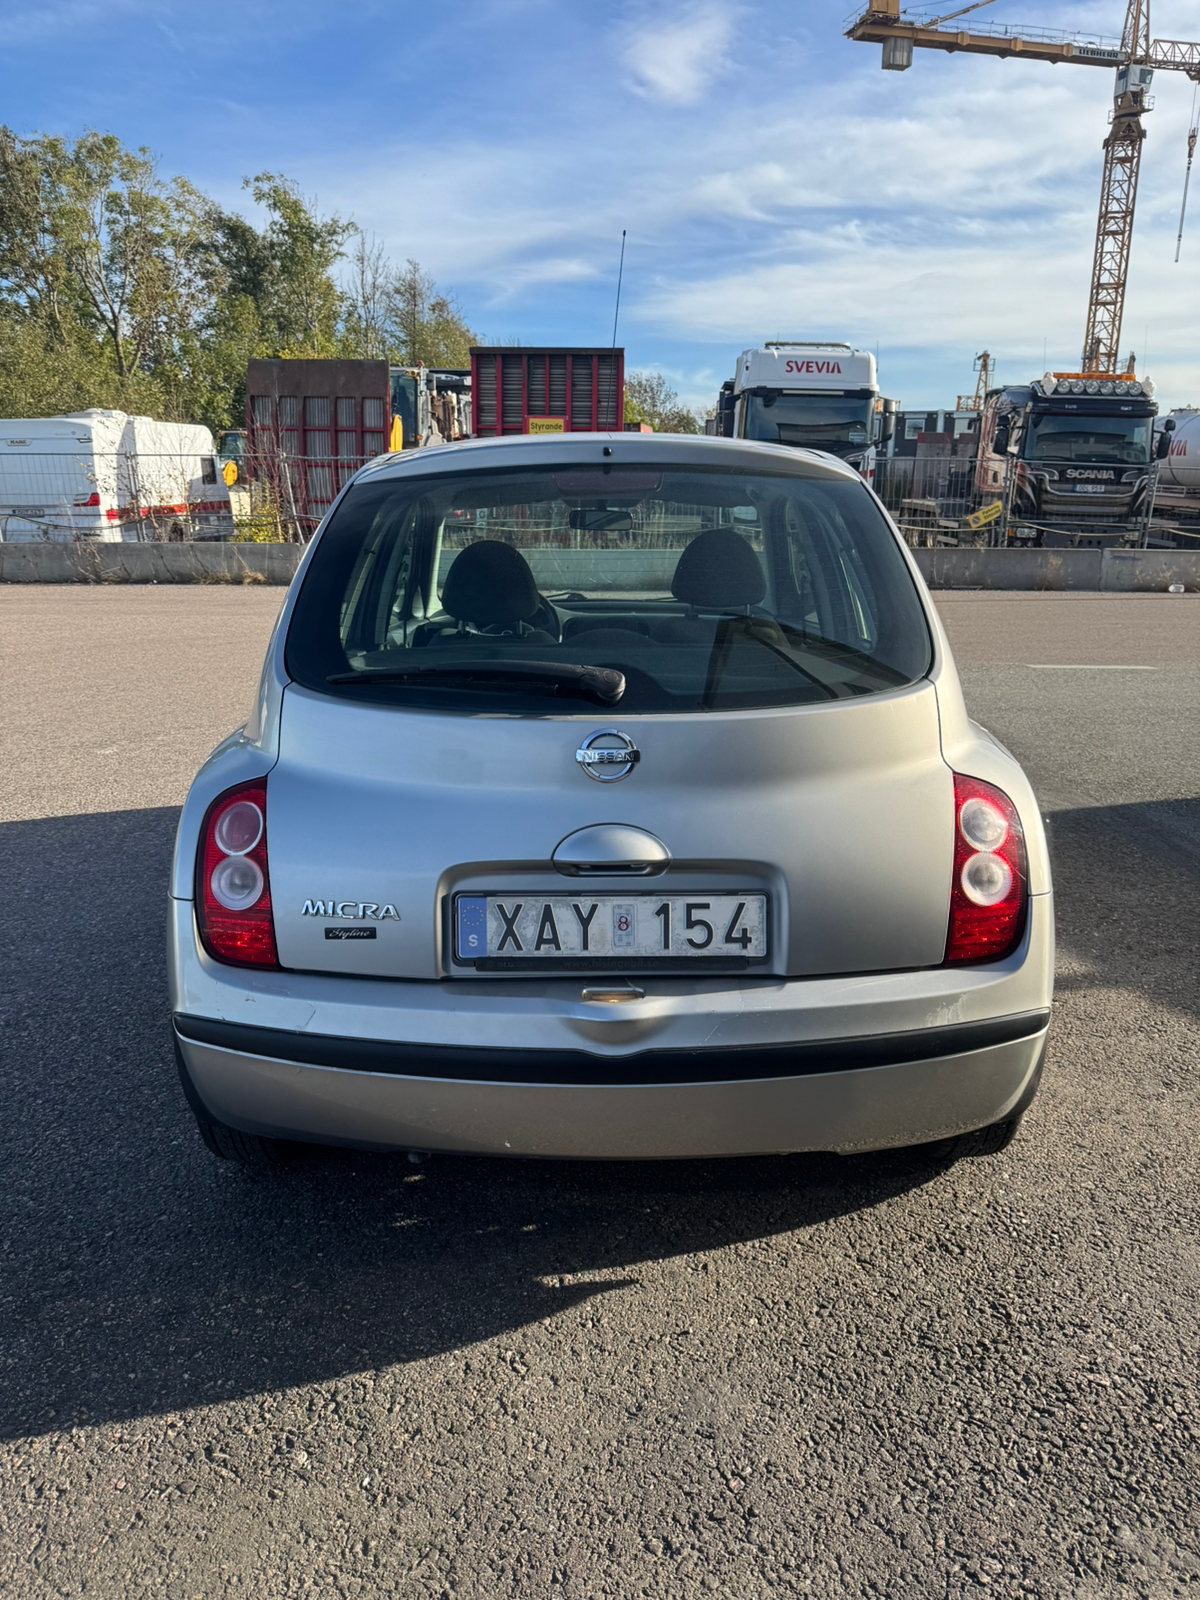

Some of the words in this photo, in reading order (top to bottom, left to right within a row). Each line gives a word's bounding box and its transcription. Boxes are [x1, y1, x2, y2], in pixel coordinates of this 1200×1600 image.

[1079, 49, 1119, 58] LIEBHERR
[785, 360, 842, 374] SVEVIA
[530, 422, 563, 431] Styrande
[1065, 468, 1115, 480] SCANIA
[583, 751, 635, 761] NISSAN
[301, 899, 401, 921] MICRA
[496, 903, 598, 951] XAY
[654, 902, 752, 950] 154
[468, 934, 479, 947] S
